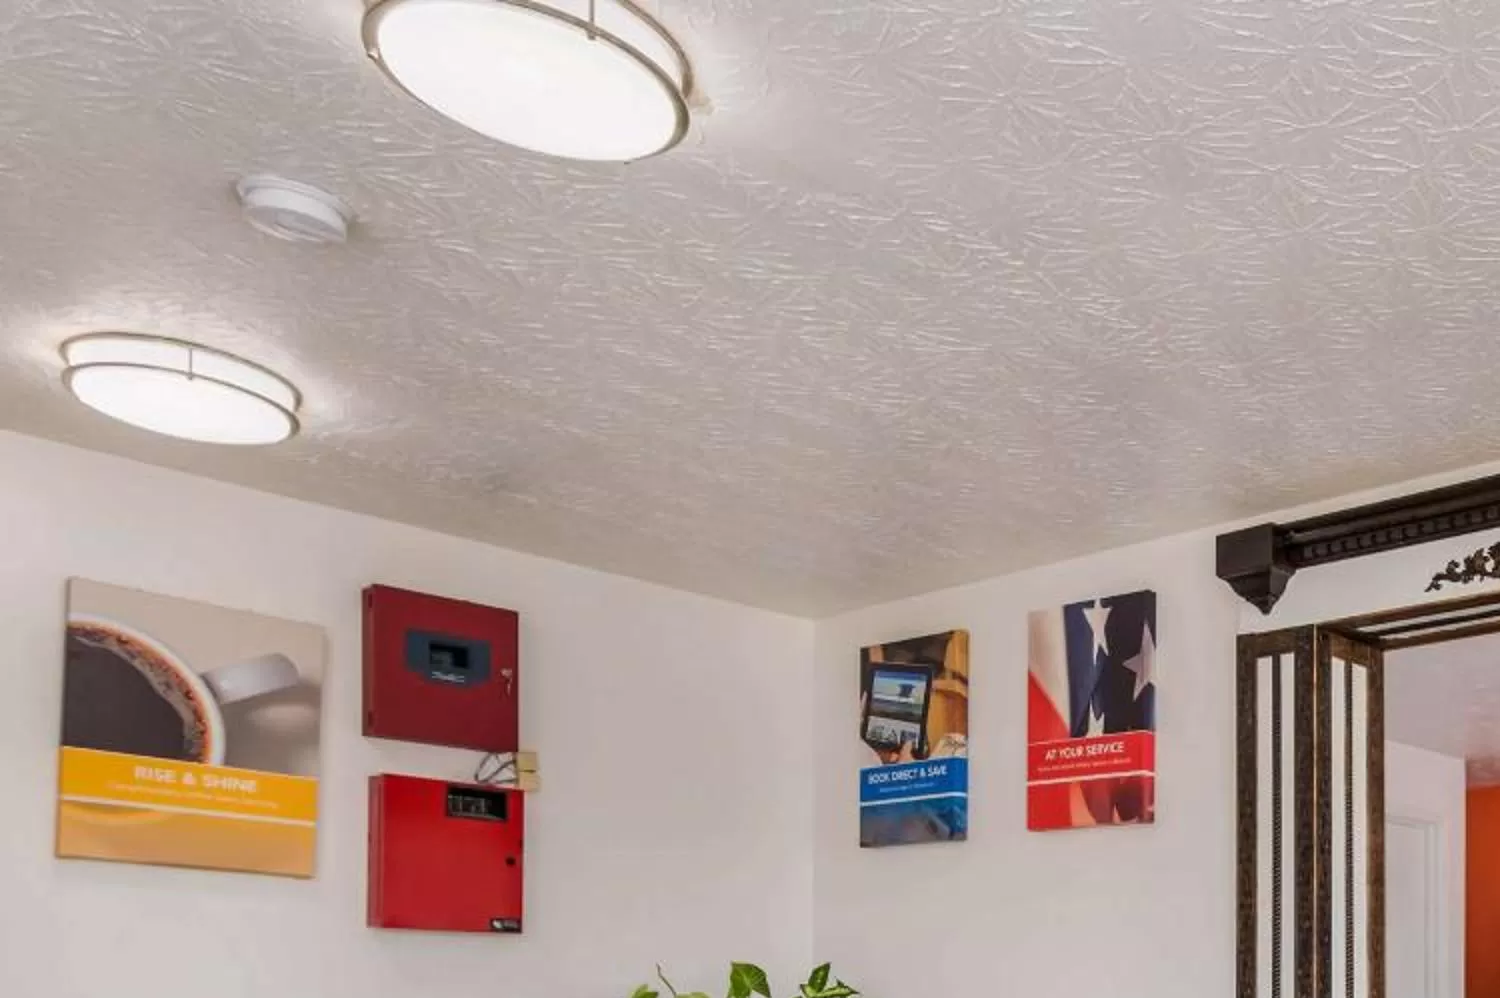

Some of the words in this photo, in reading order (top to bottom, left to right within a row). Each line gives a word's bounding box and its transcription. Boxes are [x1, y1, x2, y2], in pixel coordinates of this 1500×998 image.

[1045, 749, 1056, 760] AT
[1060, 746, 1084, 759] YOUR
[1086, 741, 1124, 756] SERVICE
[134, 766, 177, 783] RISE
[182, 771, 197, 785] &
[203, 774, 257, 793] SHINE
[868, 772, 890, 784] BOOK
[892, 768, 918, 780] DIRECT
[928, 765, 947, 777] SAVE
